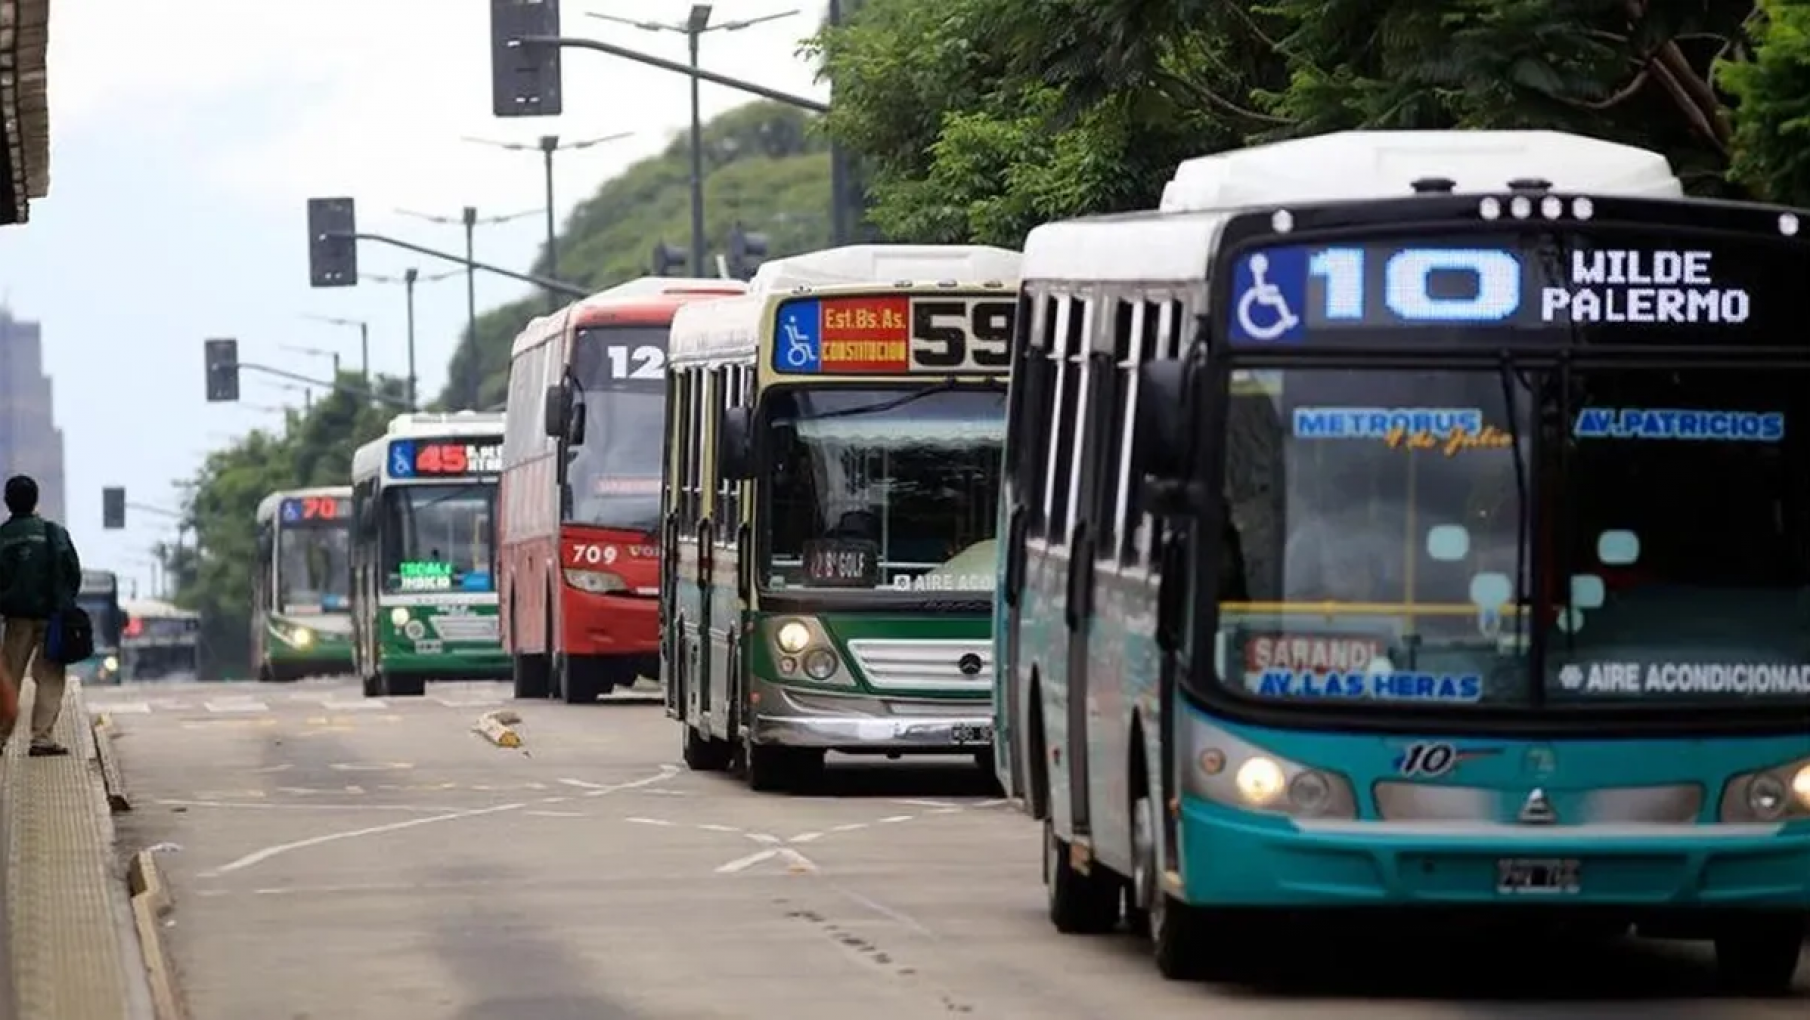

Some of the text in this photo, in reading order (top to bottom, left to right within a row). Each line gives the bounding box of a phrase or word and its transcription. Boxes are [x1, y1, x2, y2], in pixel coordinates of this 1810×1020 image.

[1572, 250, 1712, 285] WILDE
[1308, 247, 1520, 320] 10
[1542, 288, 1750, 322] PALERMO
[912, 301, 1016, 367] 59
[416, 444, 467, 473] 45
[302, 497, 337, 519] 70
[572, 545, 617, 565] 709
[913, 573, 953, 591] AIRE
[1373, 674, 1480, 698] HERAS
[1587, 663, 1640, 692] AIRE
[1403, 742, 1454, 775] 10
